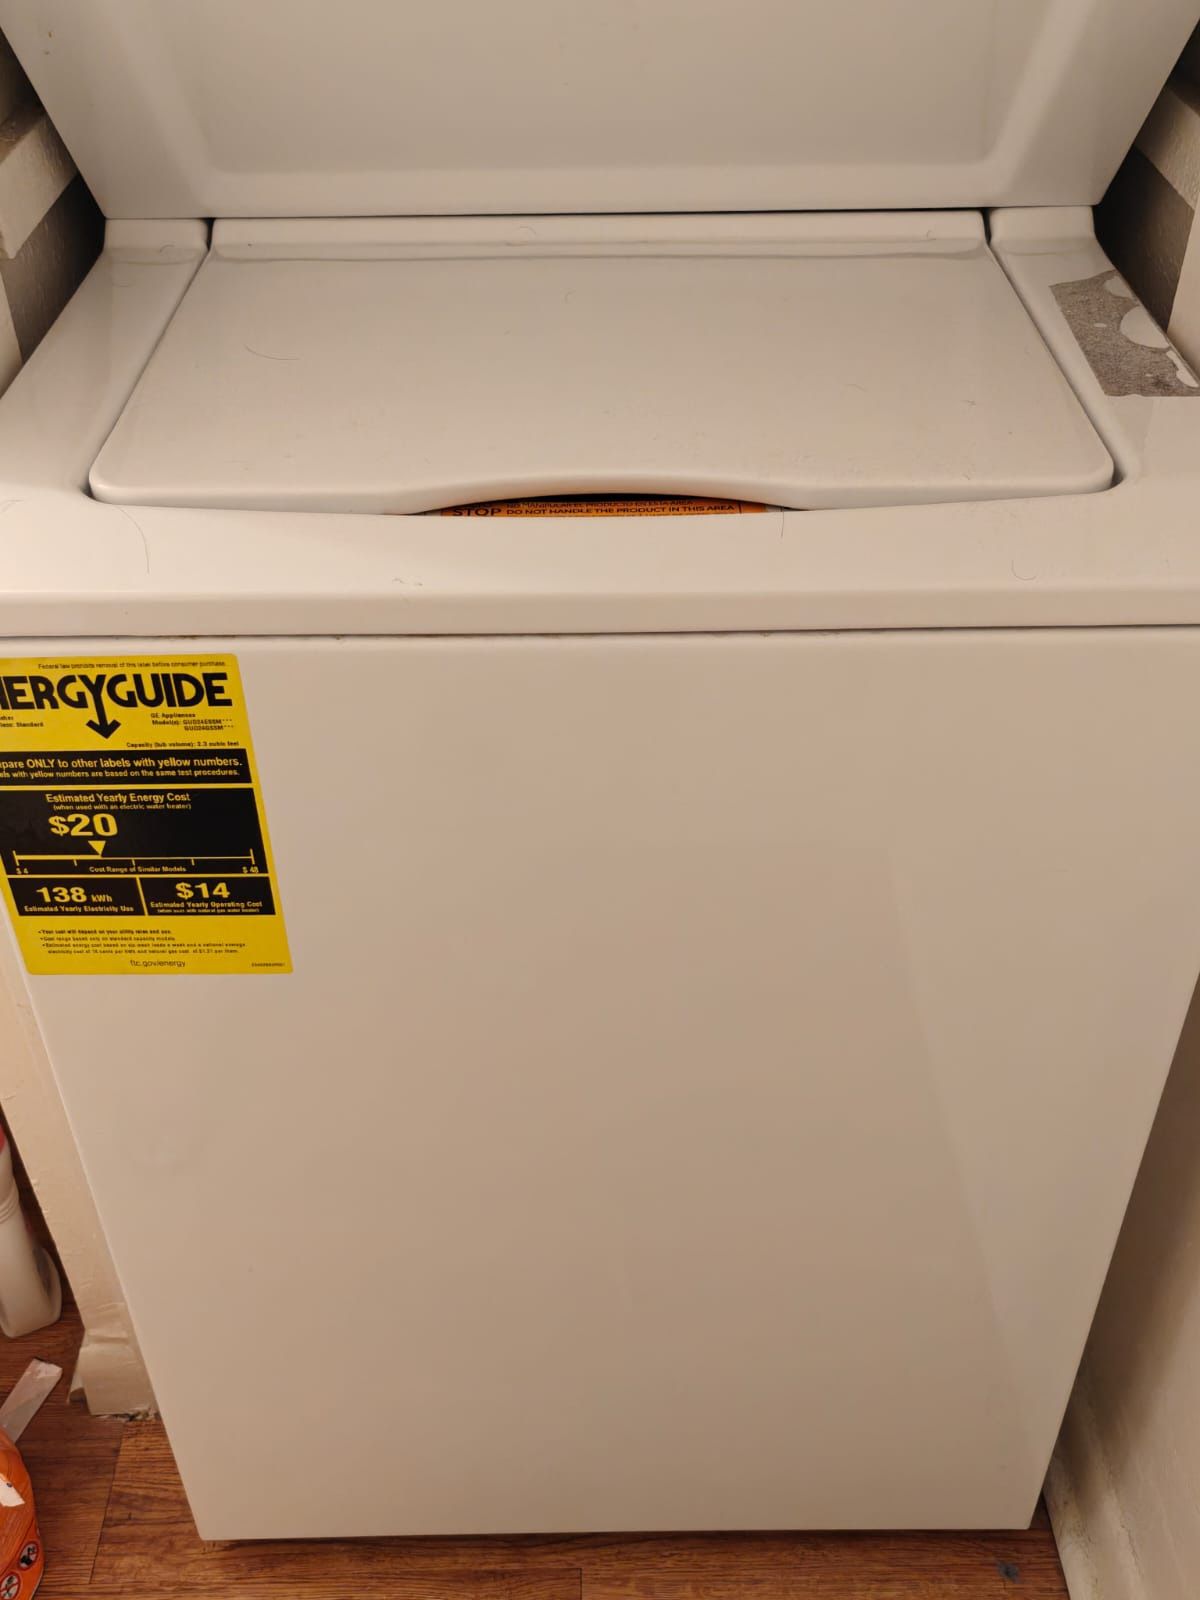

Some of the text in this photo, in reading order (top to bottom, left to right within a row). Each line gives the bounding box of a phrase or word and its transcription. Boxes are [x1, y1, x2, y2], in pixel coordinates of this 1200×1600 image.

[453, 508, 502, 516] STOP
[26, 758, 54, 768] ONLY
[57, 758, 69, 768] to
[71, 758, 98, 768] other
[100, 758, 132, 768] labels
[133, 757, 156, 767] with
[158, 757, 190, 767] yellow
[193, 756, 243, 766] numbers.
[46, 792, 192, 802] Estimated Yearly Energy Cost
[48, 813, 118, 836] $20
[36, 887, 112, 902] 138 kWh
[176, 882, 230, 900] $14
